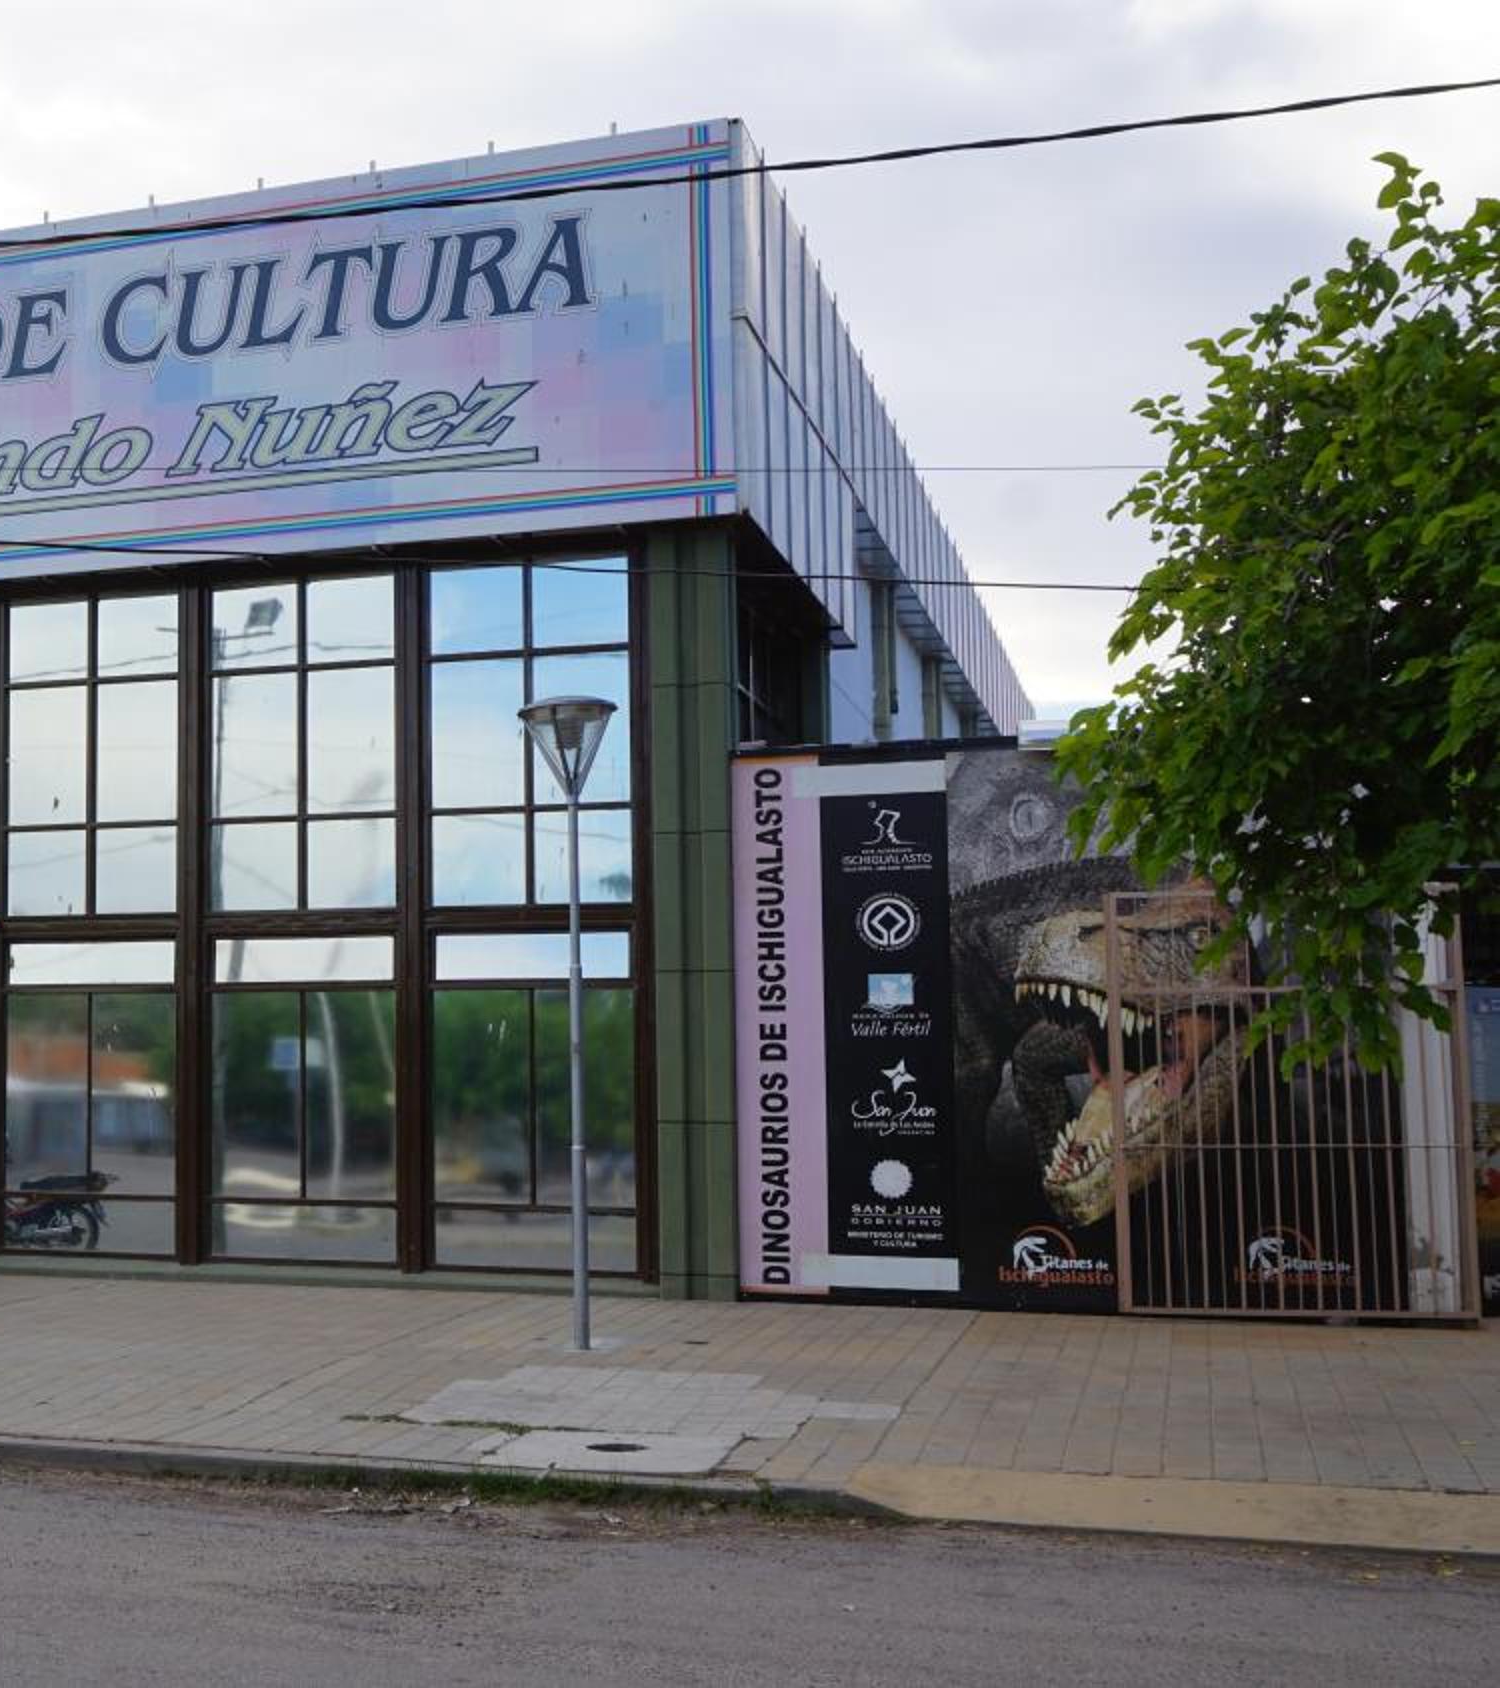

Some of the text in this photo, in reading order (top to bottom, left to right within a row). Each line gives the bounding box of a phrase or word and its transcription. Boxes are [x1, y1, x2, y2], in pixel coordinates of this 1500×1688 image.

[102, 217, 594, 365] CULTURA
[166, 377, 540, 478] Nuñez
[754, 768, 791, 1286] DINOSAURIOS DE ISCHIGUALASTO
[851, 1020, 888, 1036] Valle
[851, 1090, 892, 1119] San
[851, 1204, 941, 1215] SAN JUAN
